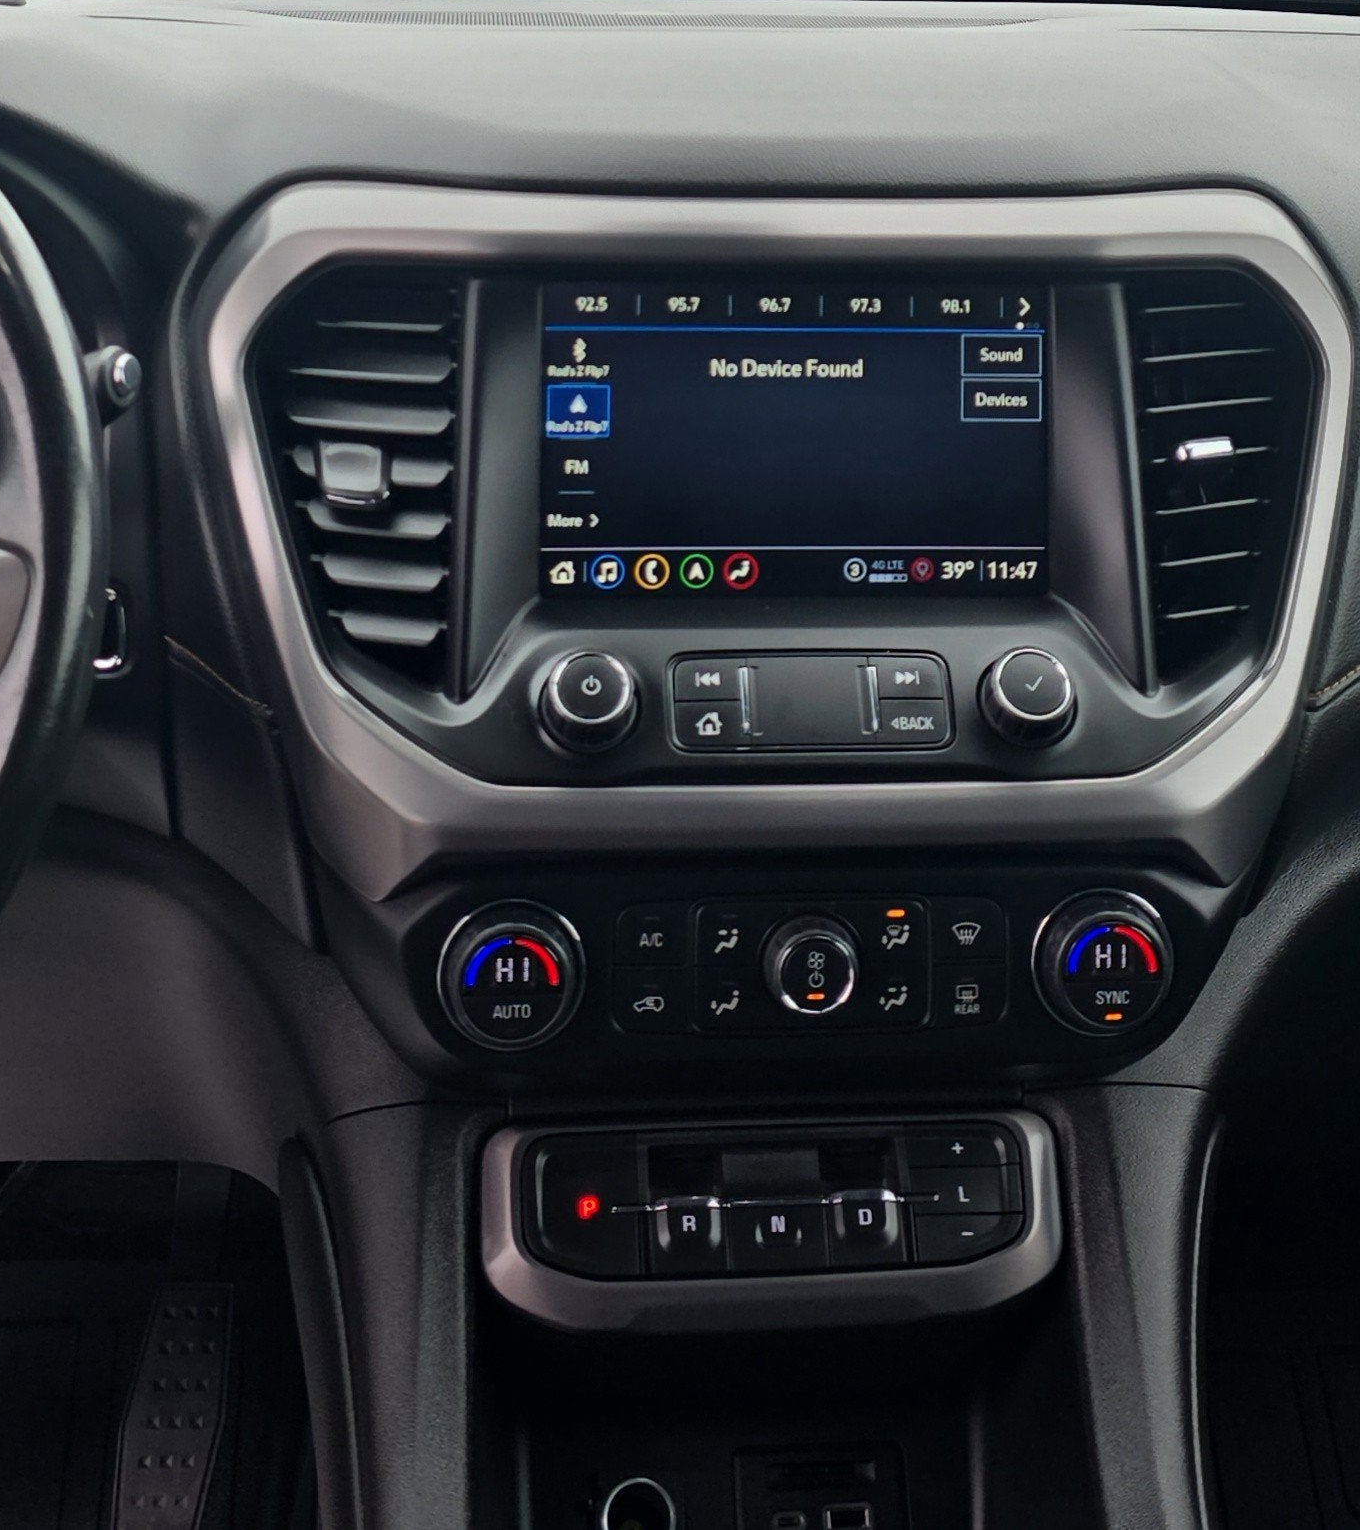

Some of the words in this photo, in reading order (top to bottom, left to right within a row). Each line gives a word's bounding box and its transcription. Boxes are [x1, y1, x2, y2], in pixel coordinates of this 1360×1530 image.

[575, 296, 609, 313] 92.5
[667, 297, 701, 313] 95.7
[758, 297, 792, 314] 96.7
[849, 298, 882, 315] 97.3
[940, 299, 972, 315] 98.1
[980, 347, 1024, 363] Sound
[709, 358, 739, 378] No
[741, 358, 801, 379] Device
[804, 359, 865, 379] Found
[975, 391, 1029, 408] Devices
[564, 458, 590, 475] FM
[546, 513, 584, 528] More
[871, 559, 886, 571] 4G
[887, 559, 905, 571] LTE
[987, 560, 1039, 580] 11:47
[899, 716, 935, 730] BACK
[639, 933, 664, 948] A/C
[1094, 943, 1128, 969] HI
[495, 957, 530, 983] HI
[1095, 990, 1131, 1006] SYNC
[492, 1003, 532, 1020] AUTO
[954, 1002, 981, 1015] REAR
[957, 1185, 971, 1203] L
[579, 1194, 600, 1220] P
[681, 1215, 697, 1233] R
[770, 1215, 786, 1233] N
[857, 1208, 873, 1226] D
